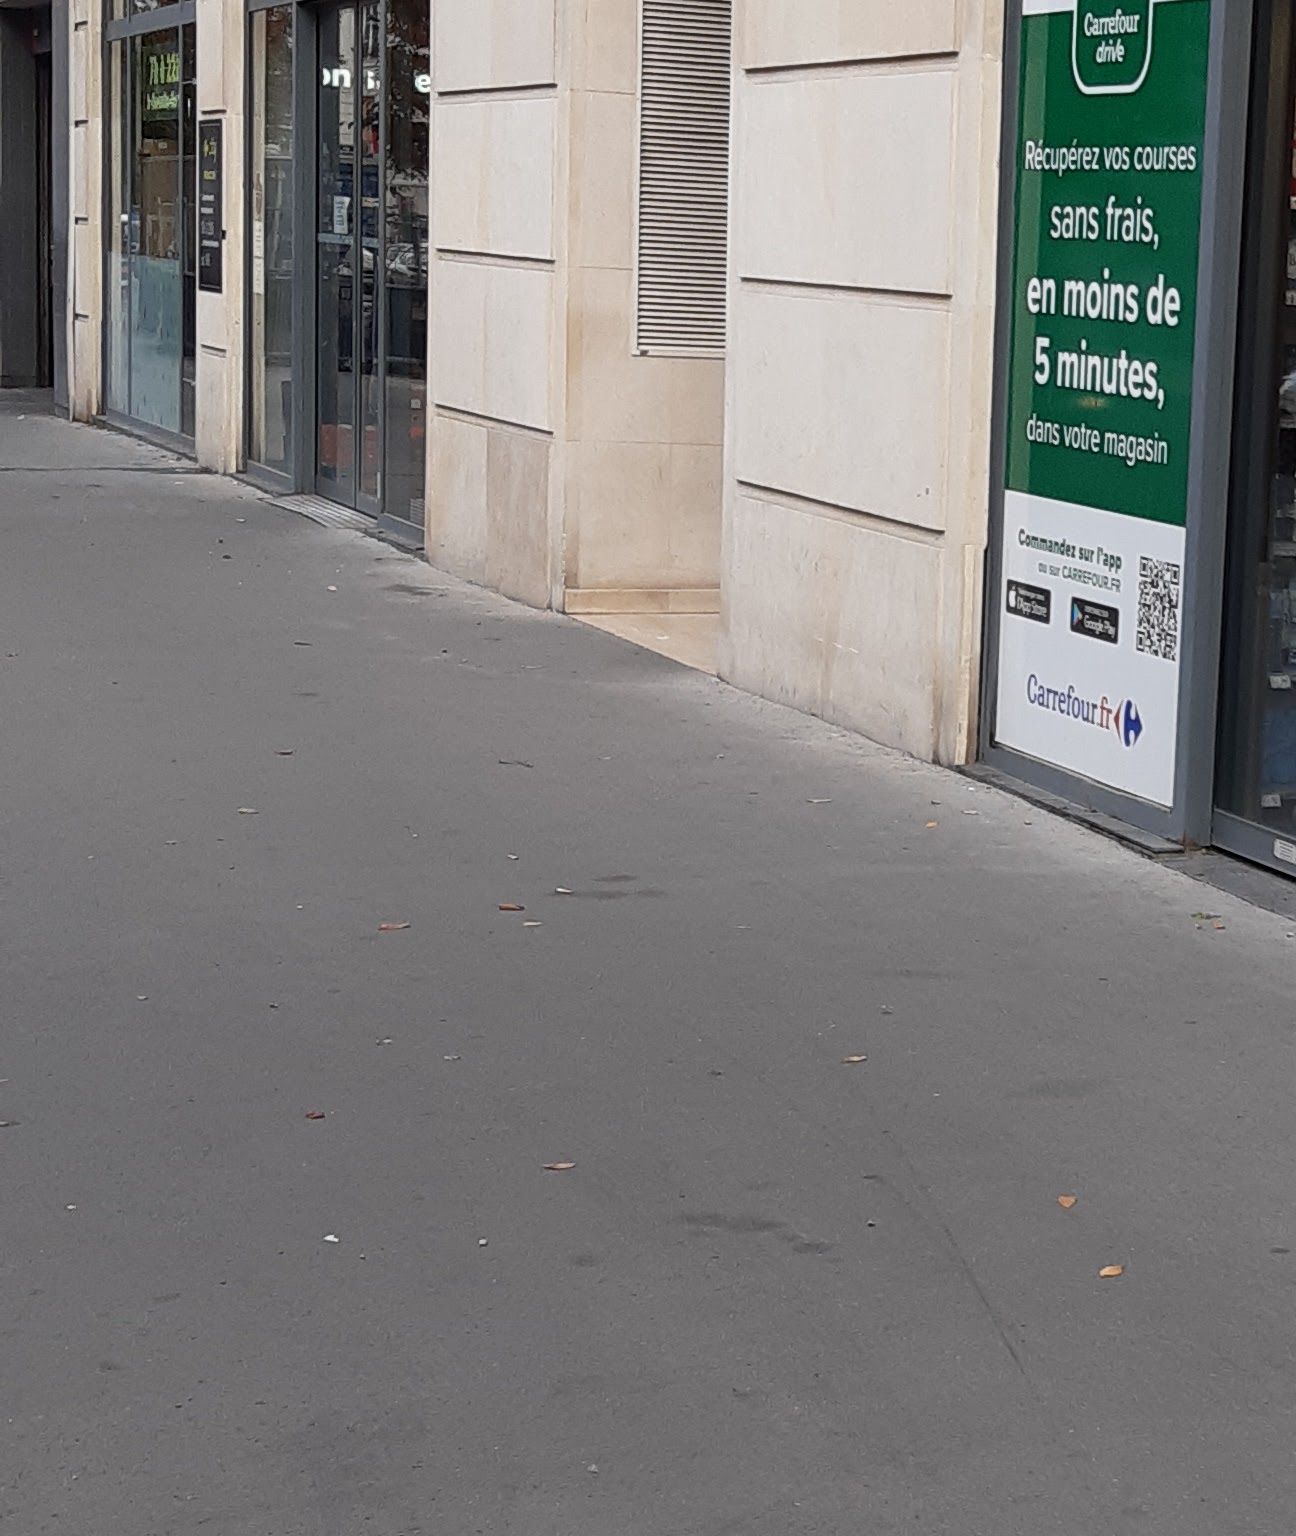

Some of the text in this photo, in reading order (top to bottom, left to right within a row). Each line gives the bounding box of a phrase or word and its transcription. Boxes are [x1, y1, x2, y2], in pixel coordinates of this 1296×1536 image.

[1084, 8, 1140, 36] Carrefour
[1096, 38, 1125, 63] drive
[1024, 138, 1197, 177] Récupérez vos courses
[1050, 195, 1160, 250] sans frais,
[1027, 267, 1181, 326] en moins de
[1034, 336, 1165, 410] 5 minutes,
[1026, 413, 1168, 467] dans votre magasin
[1018, 527, 1077, 559] Commandez
[1079, 546, 1095, 563] sur
[1037, 562, 1121, 593] ou sur CARREFOUR.FR
[1084, 614, 1105, 634] Google
[1027, 673, 1113, 731] Carrefour.fr
